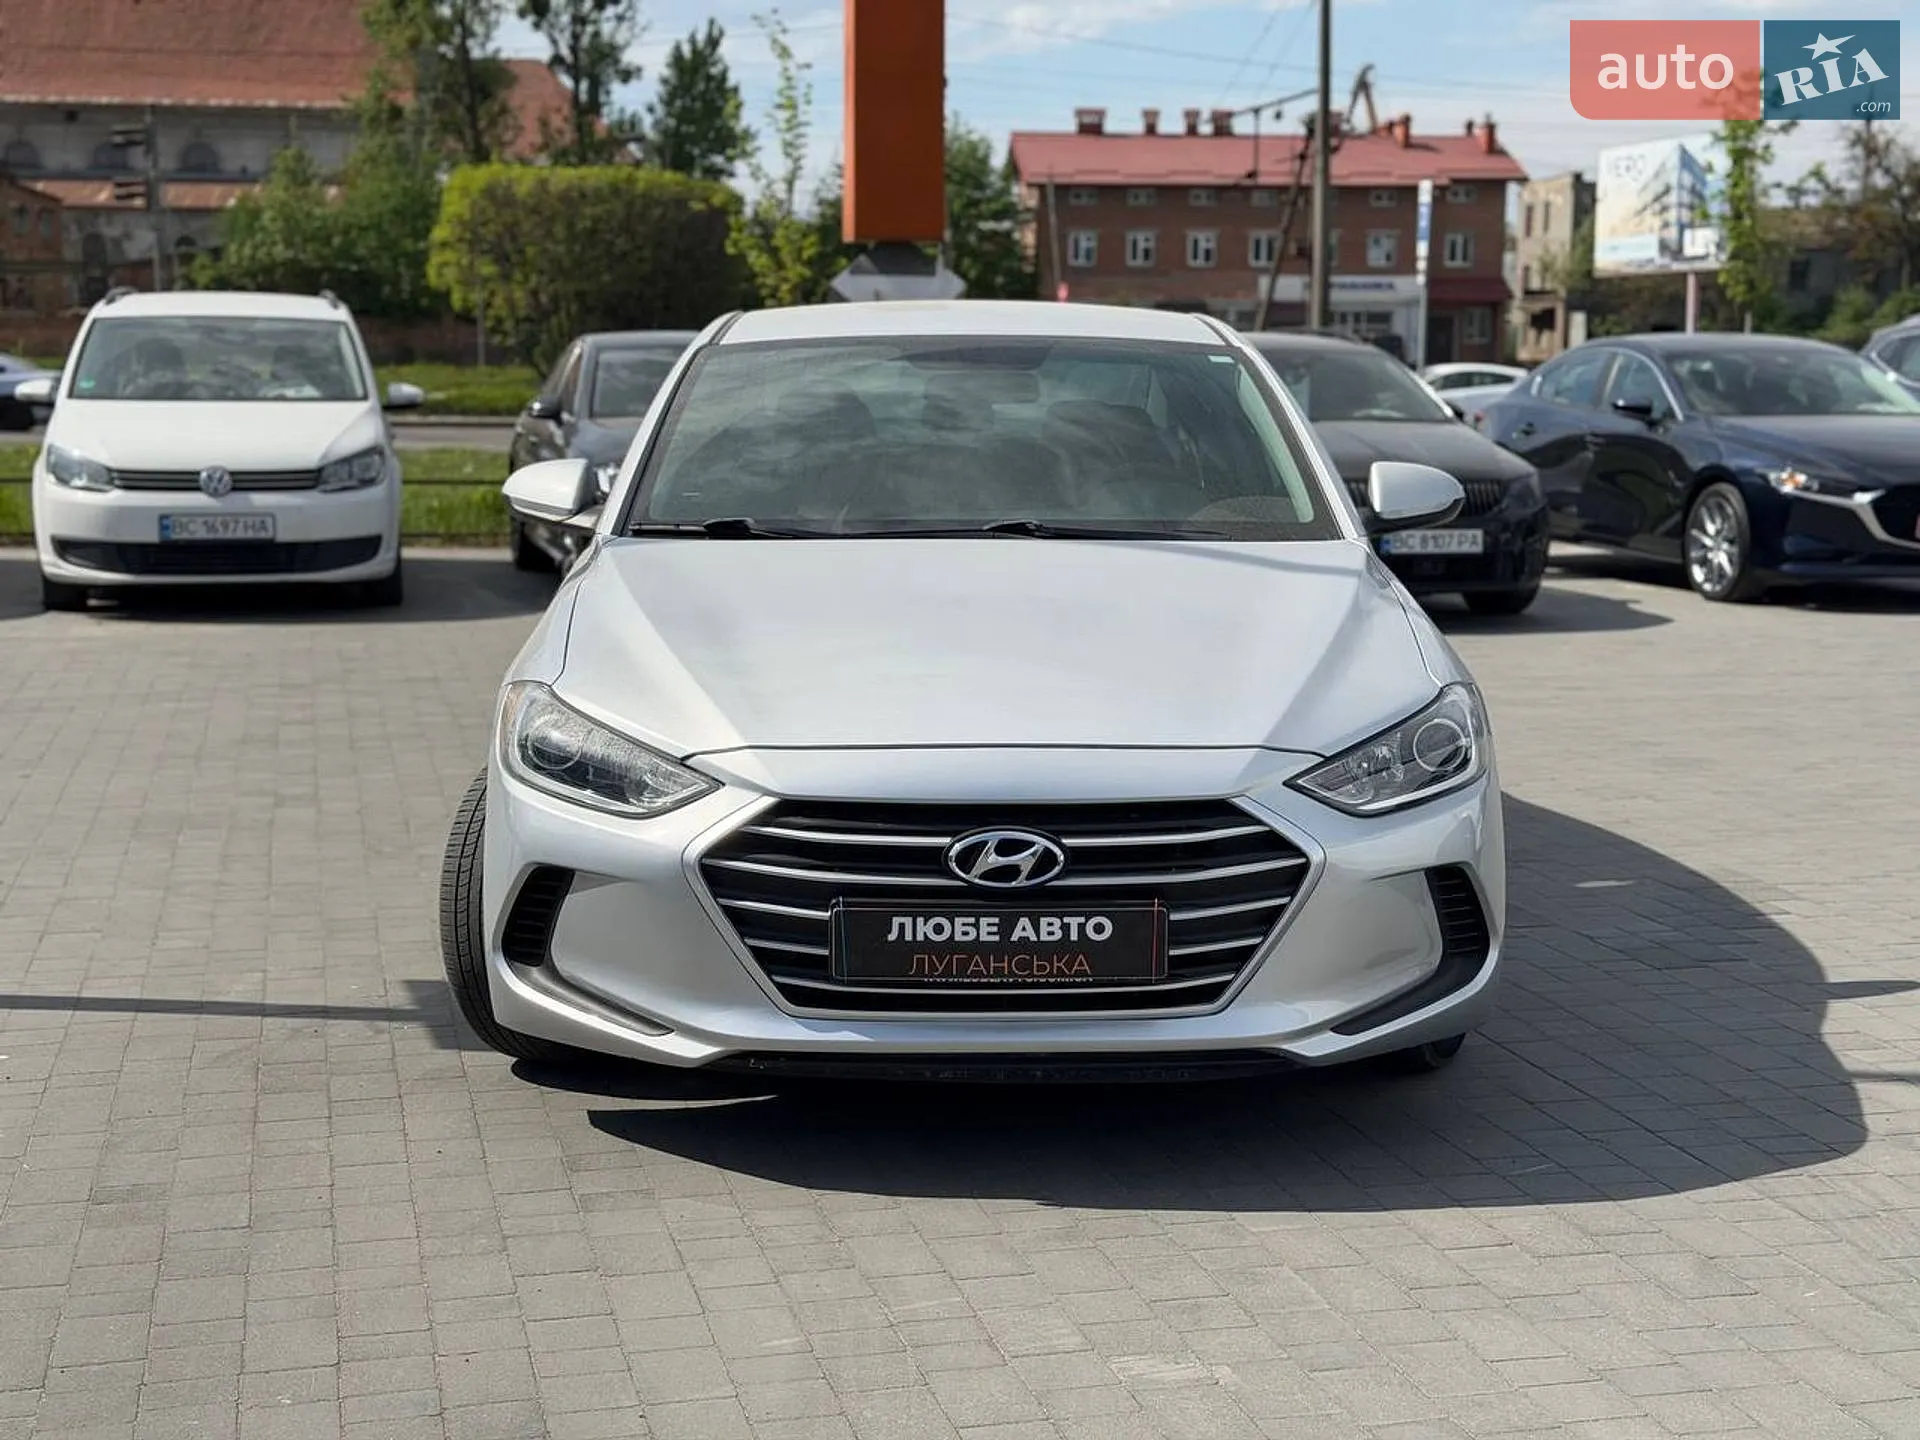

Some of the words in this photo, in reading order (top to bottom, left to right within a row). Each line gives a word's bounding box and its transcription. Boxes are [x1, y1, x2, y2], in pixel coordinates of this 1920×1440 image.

[887, 915, 1000, 942] ЛЮБЕ
[1010, 915, 1114, 942] АВТО
[908, 953, 1093, 976] ЛУГАНСЬКА
